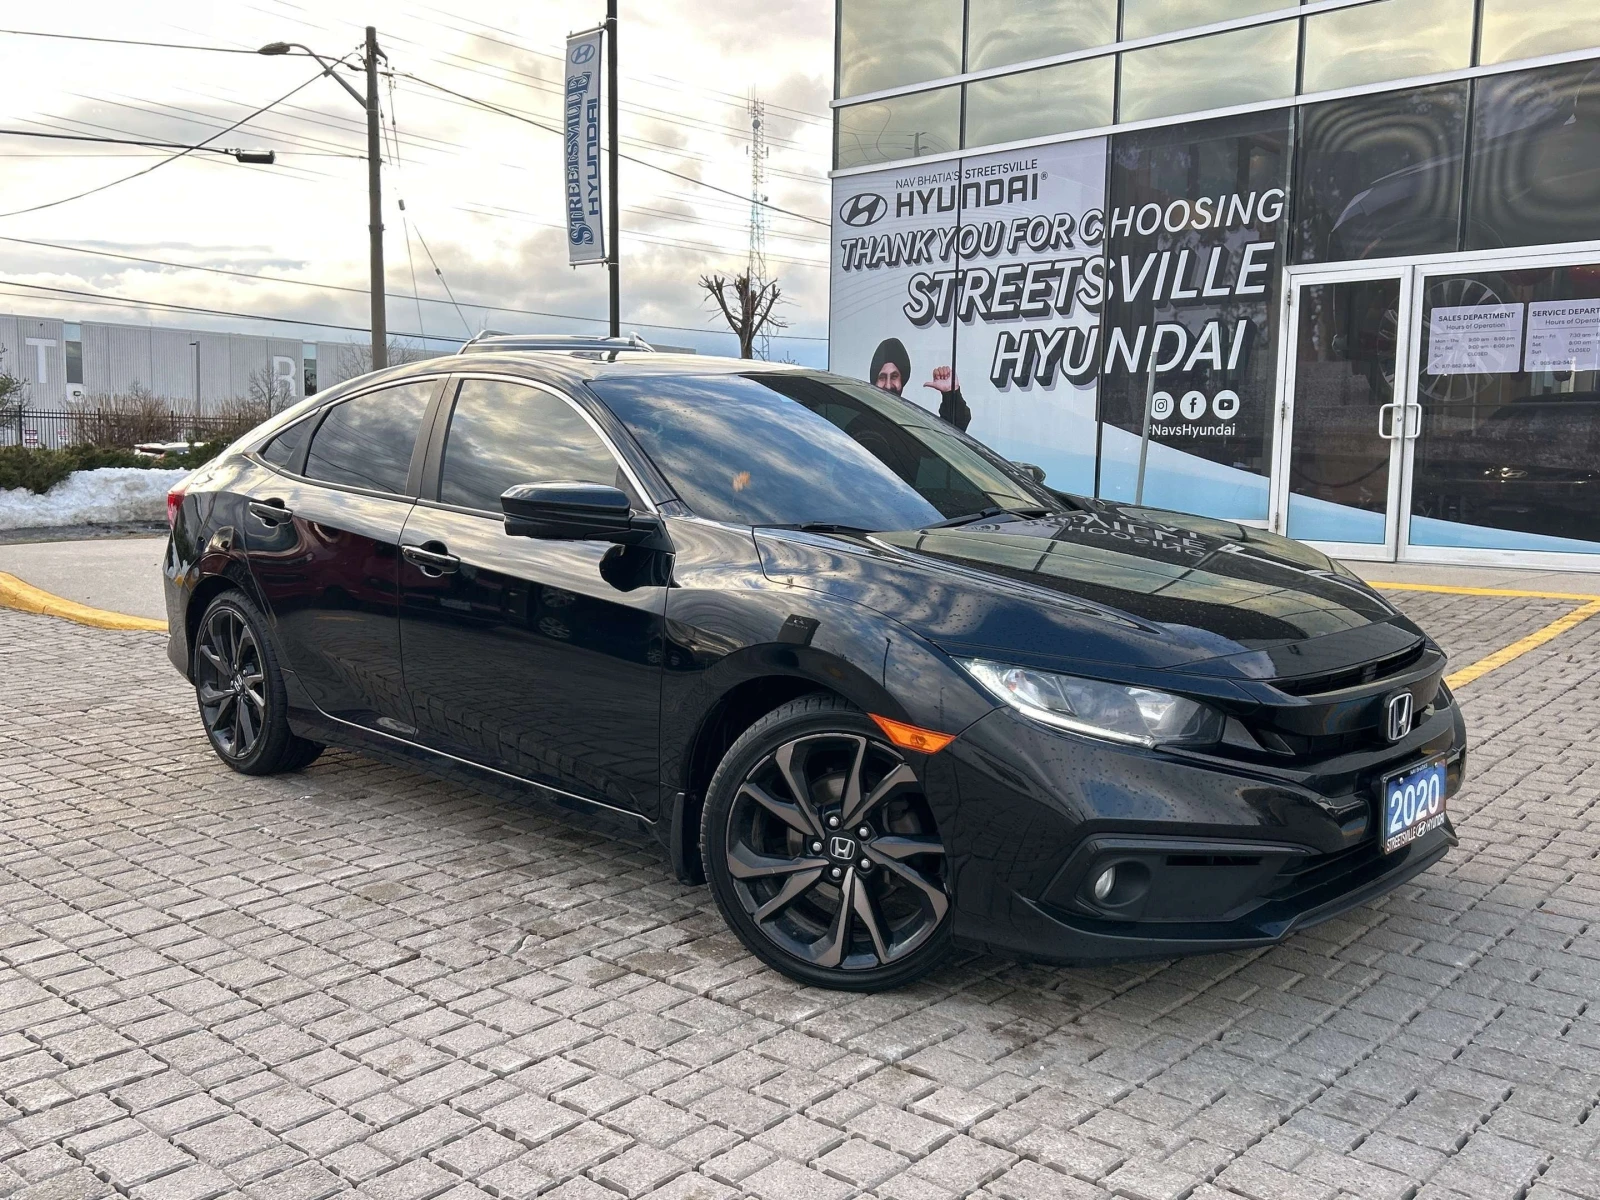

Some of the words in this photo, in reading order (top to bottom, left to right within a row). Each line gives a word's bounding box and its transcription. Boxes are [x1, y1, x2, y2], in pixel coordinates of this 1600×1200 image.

[566, 72, 594, 245] STREETSVILLE
[586, 98, 599, 215] HYUNDAI
[895, 178, 915, 189] NAV
[917, 171, 960, 186] BHATIA'S
[965, 159, 1037, 179] STREETSVILLE
[840, 228, 939, 272] THANK
[935, 219, 1006, 261] YOU
[1007, 212, 1076, 255] FOR
[1079, 188, 1284, 246] CHOOSING
[903, 241, 1276, 326] STREETSVILLE
[1532, 309, 1566, 317] SERVICE
[1438, 314, 1462, 322] SALES
[1463, 312, 1515, 321] DEPARTMENT
[1474, 322, 1506, 330] Operation
[990, 319, 1248, 389] HYUNDAI
[1390, 773, 1440, 834] 2020
